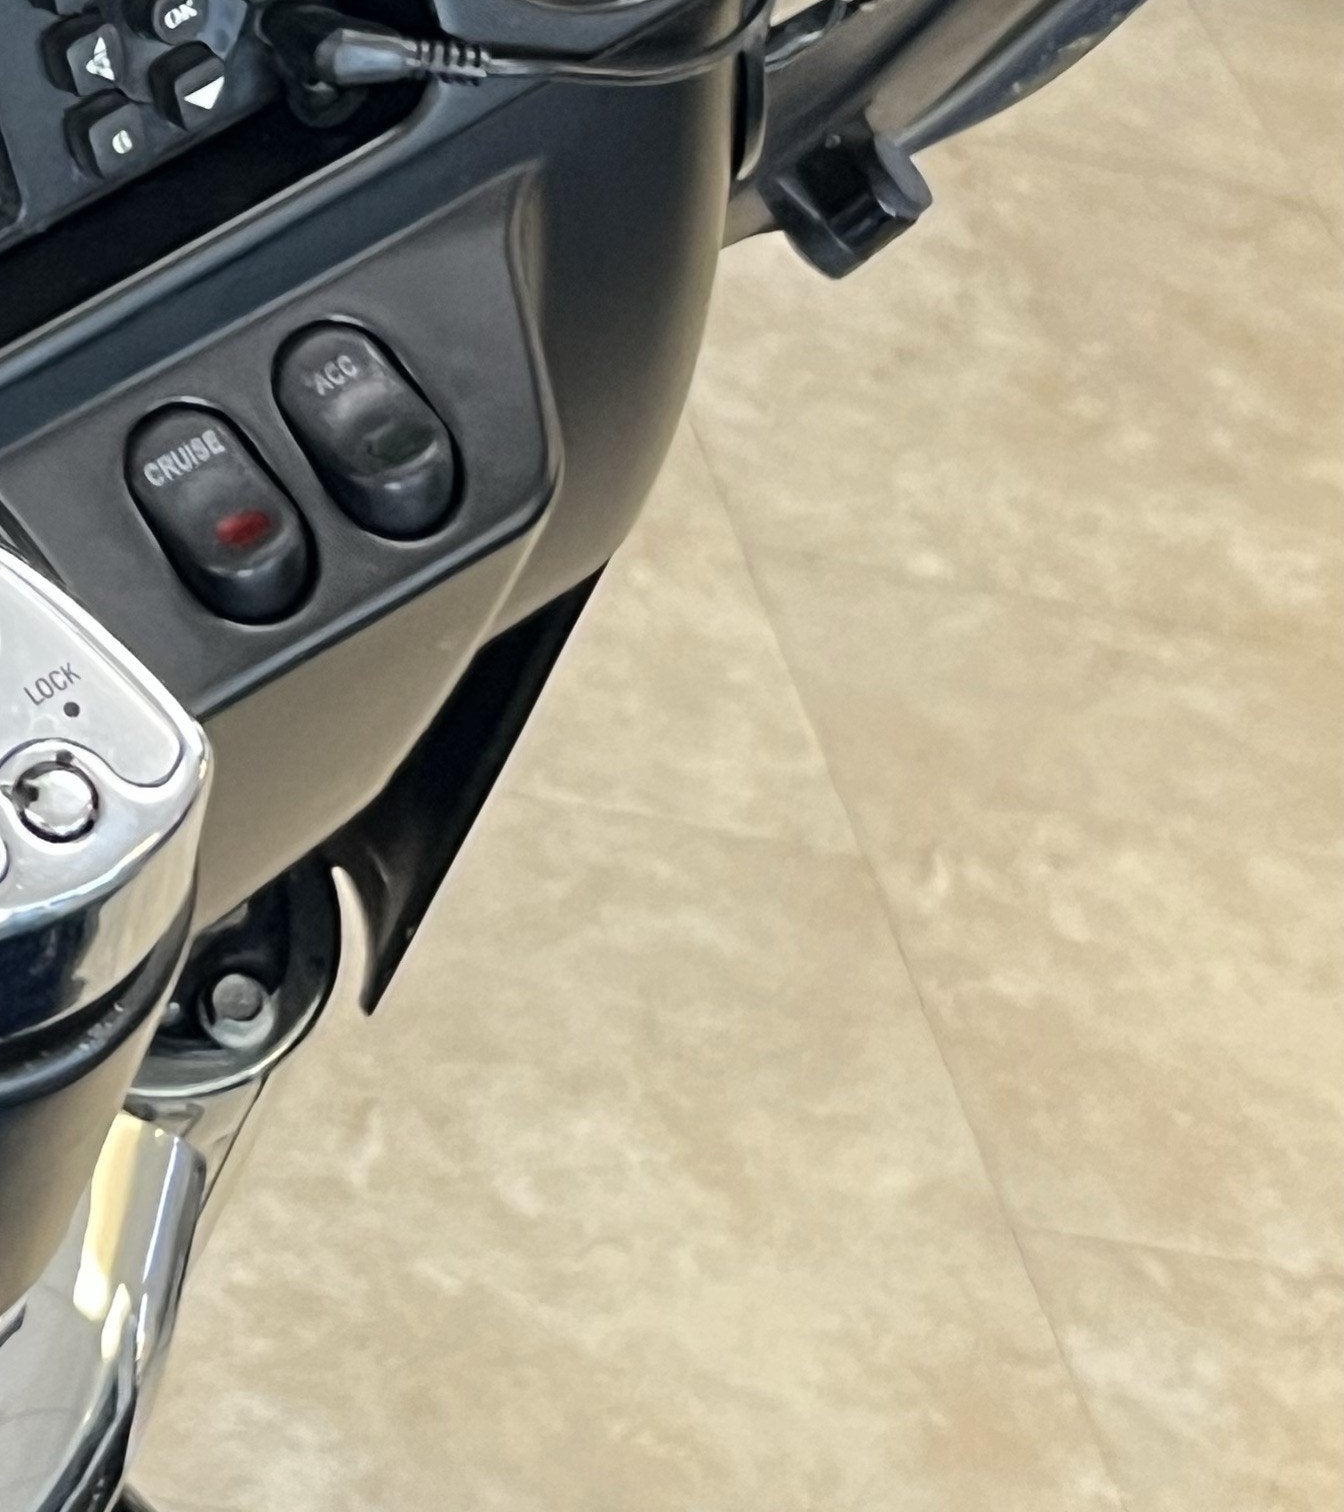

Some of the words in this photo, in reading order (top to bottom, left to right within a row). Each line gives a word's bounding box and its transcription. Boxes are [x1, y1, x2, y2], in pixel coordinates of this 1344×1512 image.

[311, 355, 357, 396] ACC
[143, 429, 226, 487] CRUISE
[22, 662, 82, 706] LOCK
